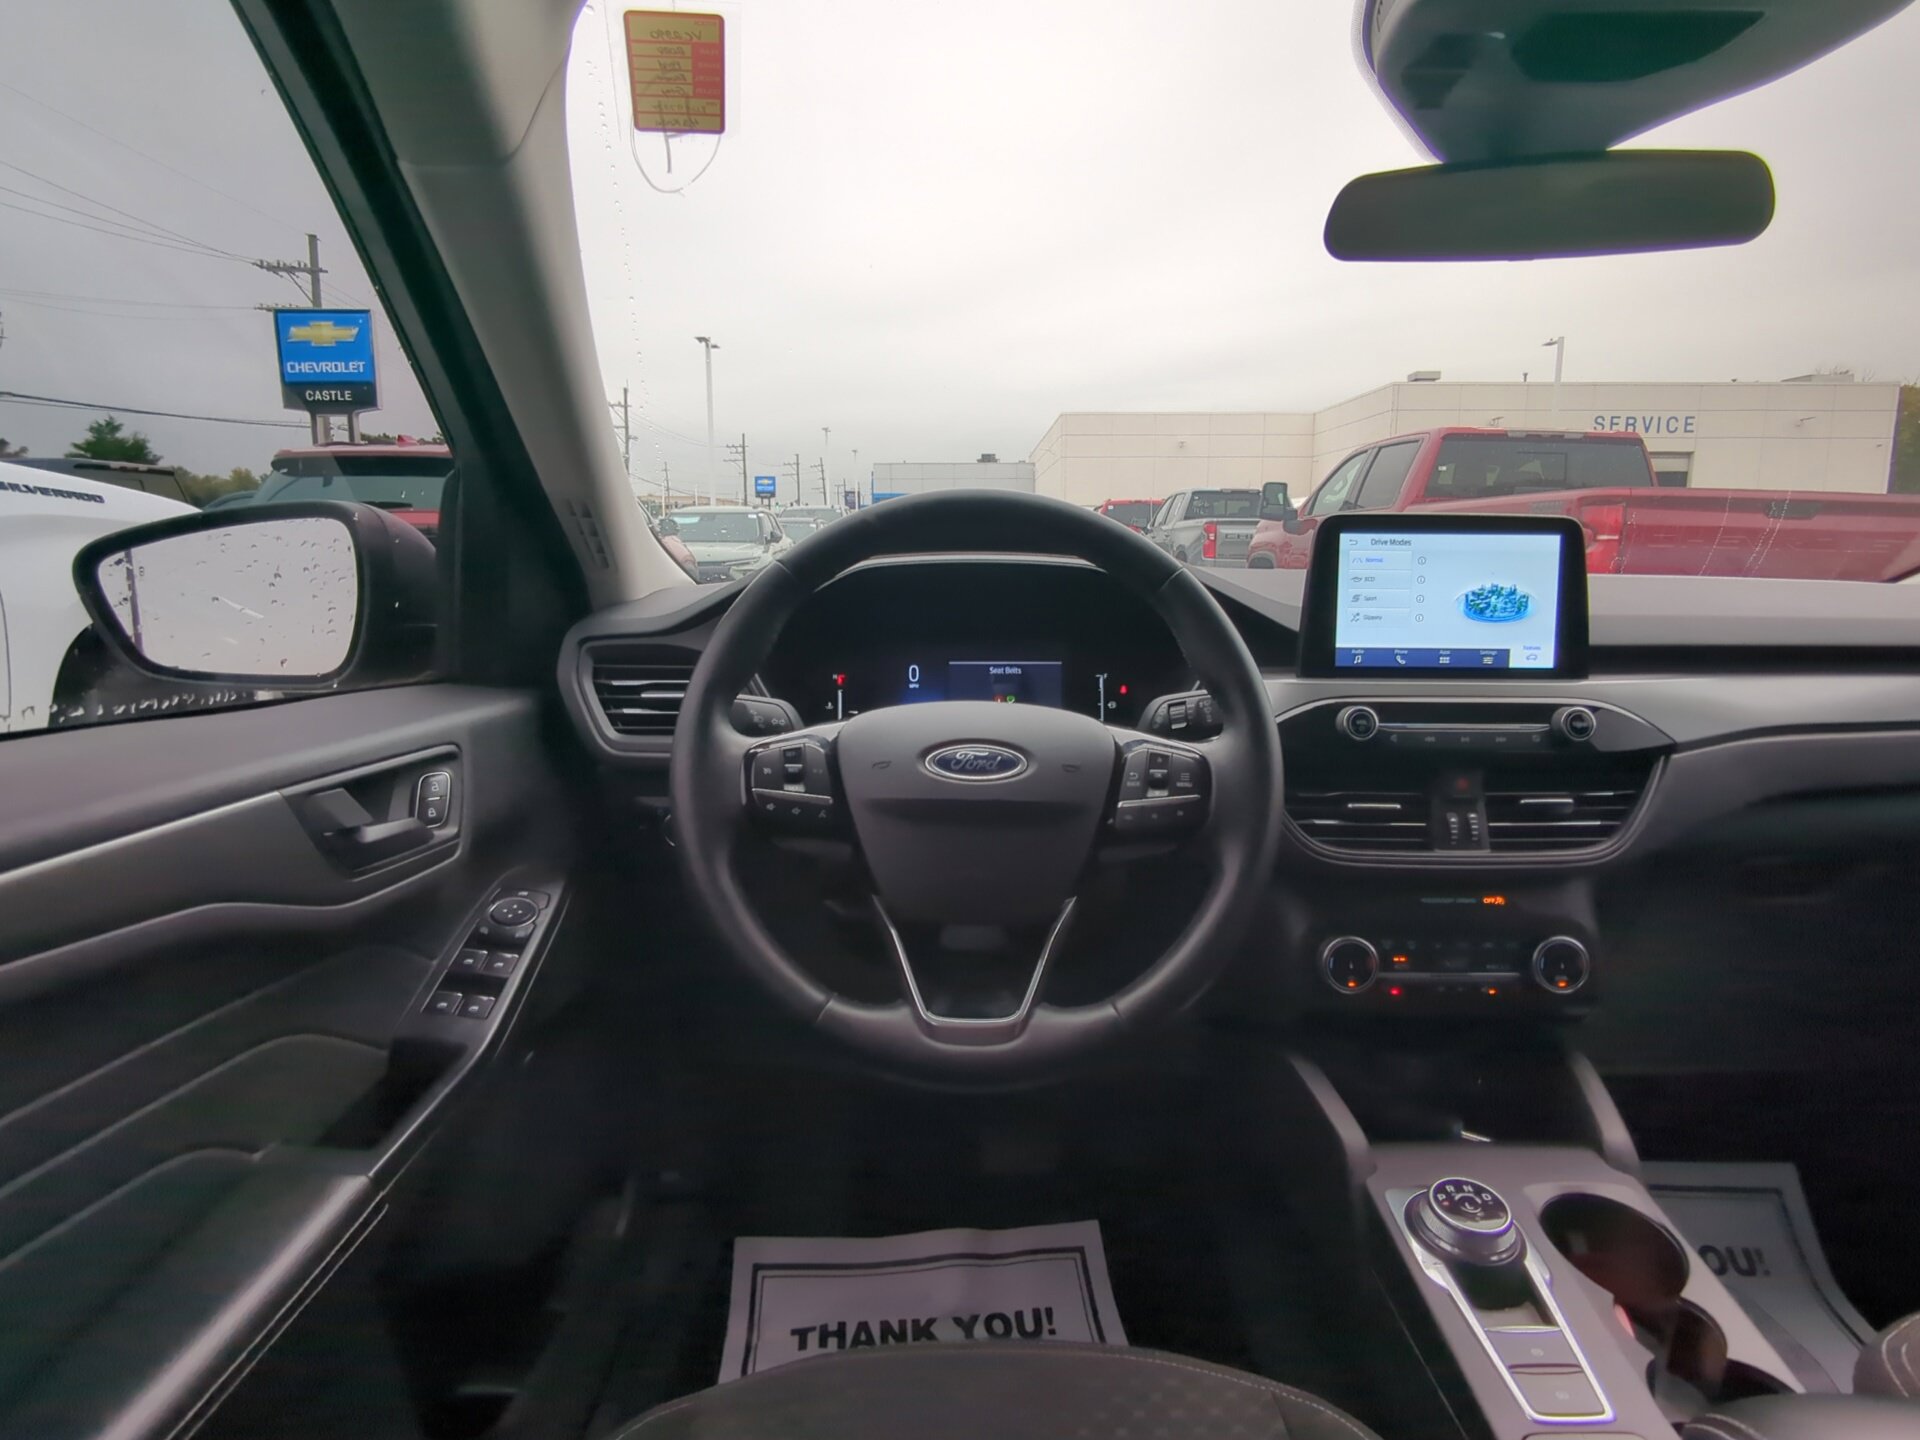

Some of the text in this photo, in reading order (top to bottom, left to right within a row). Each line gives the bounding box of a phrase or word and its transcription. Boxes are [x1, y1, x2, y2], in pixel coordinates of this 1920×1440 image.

[286, 361, 365, 373] CHEVROLET
[305, 390, 353, 401] CASTLE
[1593, 415, 1696, 434] SERVICE
[1370, 538, 1412, 546] Drive Modes
[908, 664, 920, 683] 0
[989, 666, 1022, 675] Seat Belts
[950, 750, 1002, 770] Ford
[1445, 1184, 1455, 1193] R
[1462, 1184, 1473, 1192] N
[1437, 1193, 1446, 1201] P
[1698, 1245, 1771, 1277] OU!
[790, 1307, 1056, 1351] THANK YOU!
